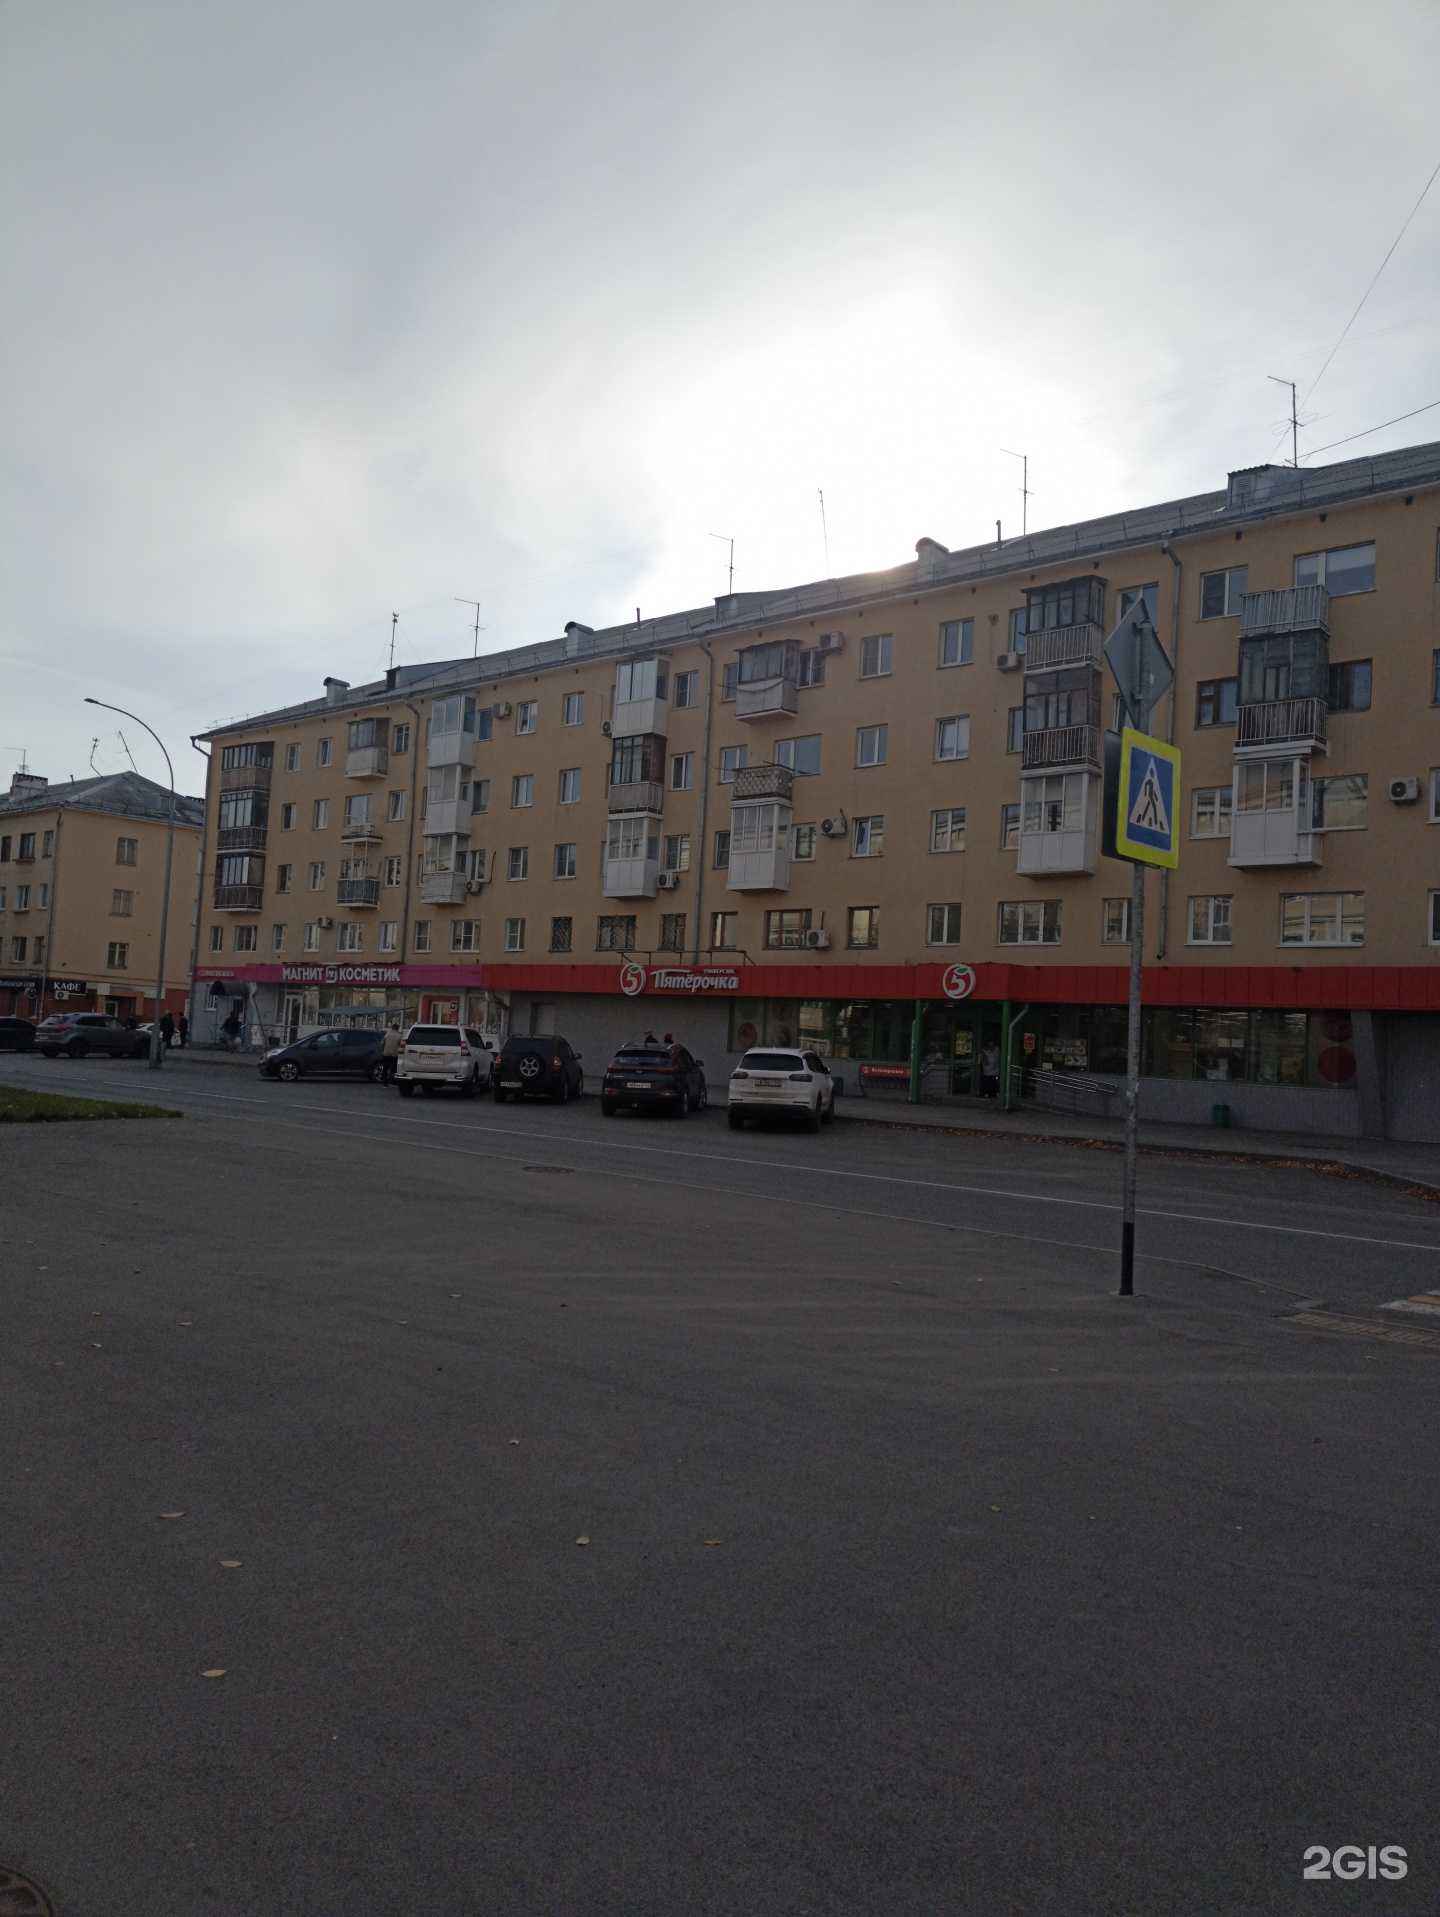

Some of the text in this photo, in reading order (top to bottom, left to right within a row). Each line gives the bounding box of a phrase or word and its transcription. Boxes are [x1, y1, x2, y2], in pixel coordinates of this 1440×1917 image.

[282, 967, 400, 982] МАГНИТ КОСМЕТИК
[650, 968, 739, 992] Пятёрочка
[53, 981, 81, 992] КАФЕ
